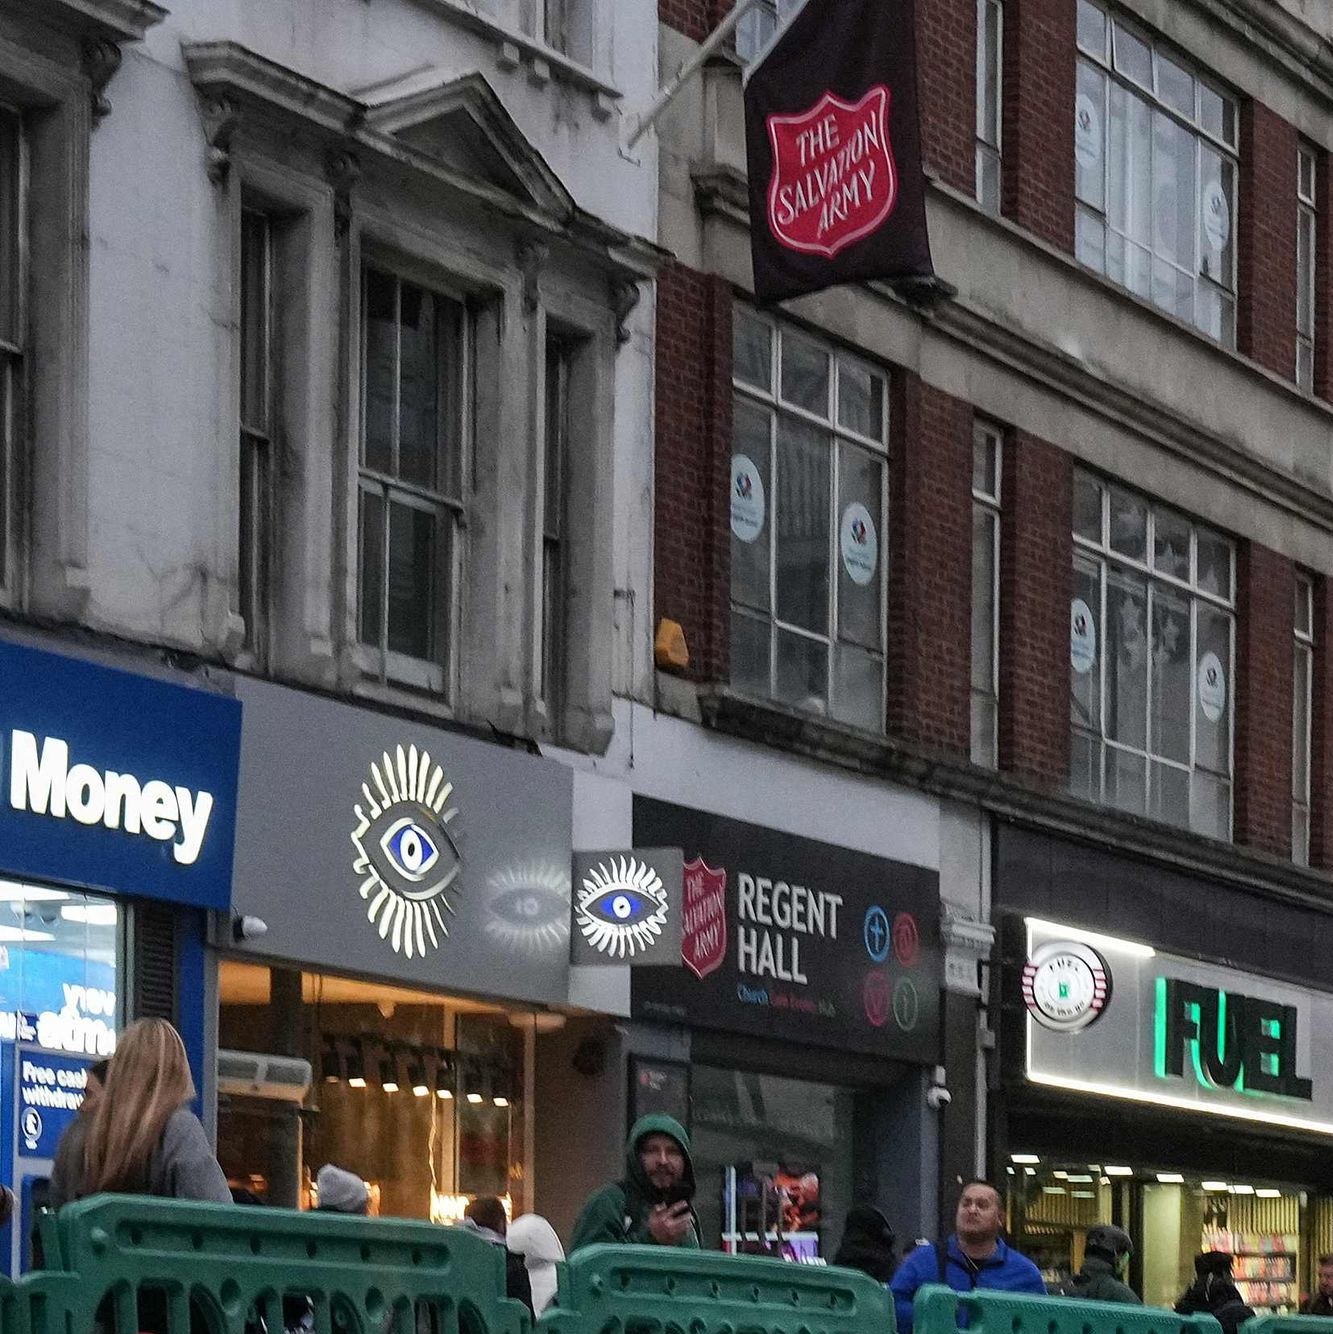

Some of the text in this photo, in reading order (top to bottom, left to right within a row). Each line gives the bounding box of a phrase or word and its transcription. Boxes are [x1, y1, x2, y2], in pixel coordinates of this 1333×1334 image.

[777, 110, 881, 225] SALVATION
[796, 114, 840, 168] THE
[816, 158, 876, 239] ARMY
[10, 729, 214, 865] Money
[737, 871, 843, 941] REGENT
[736, 925, 808, 986] HALL
[22, 1061, 56, 1085] Free
[1155, 976, 1313, 1101] FUEL
